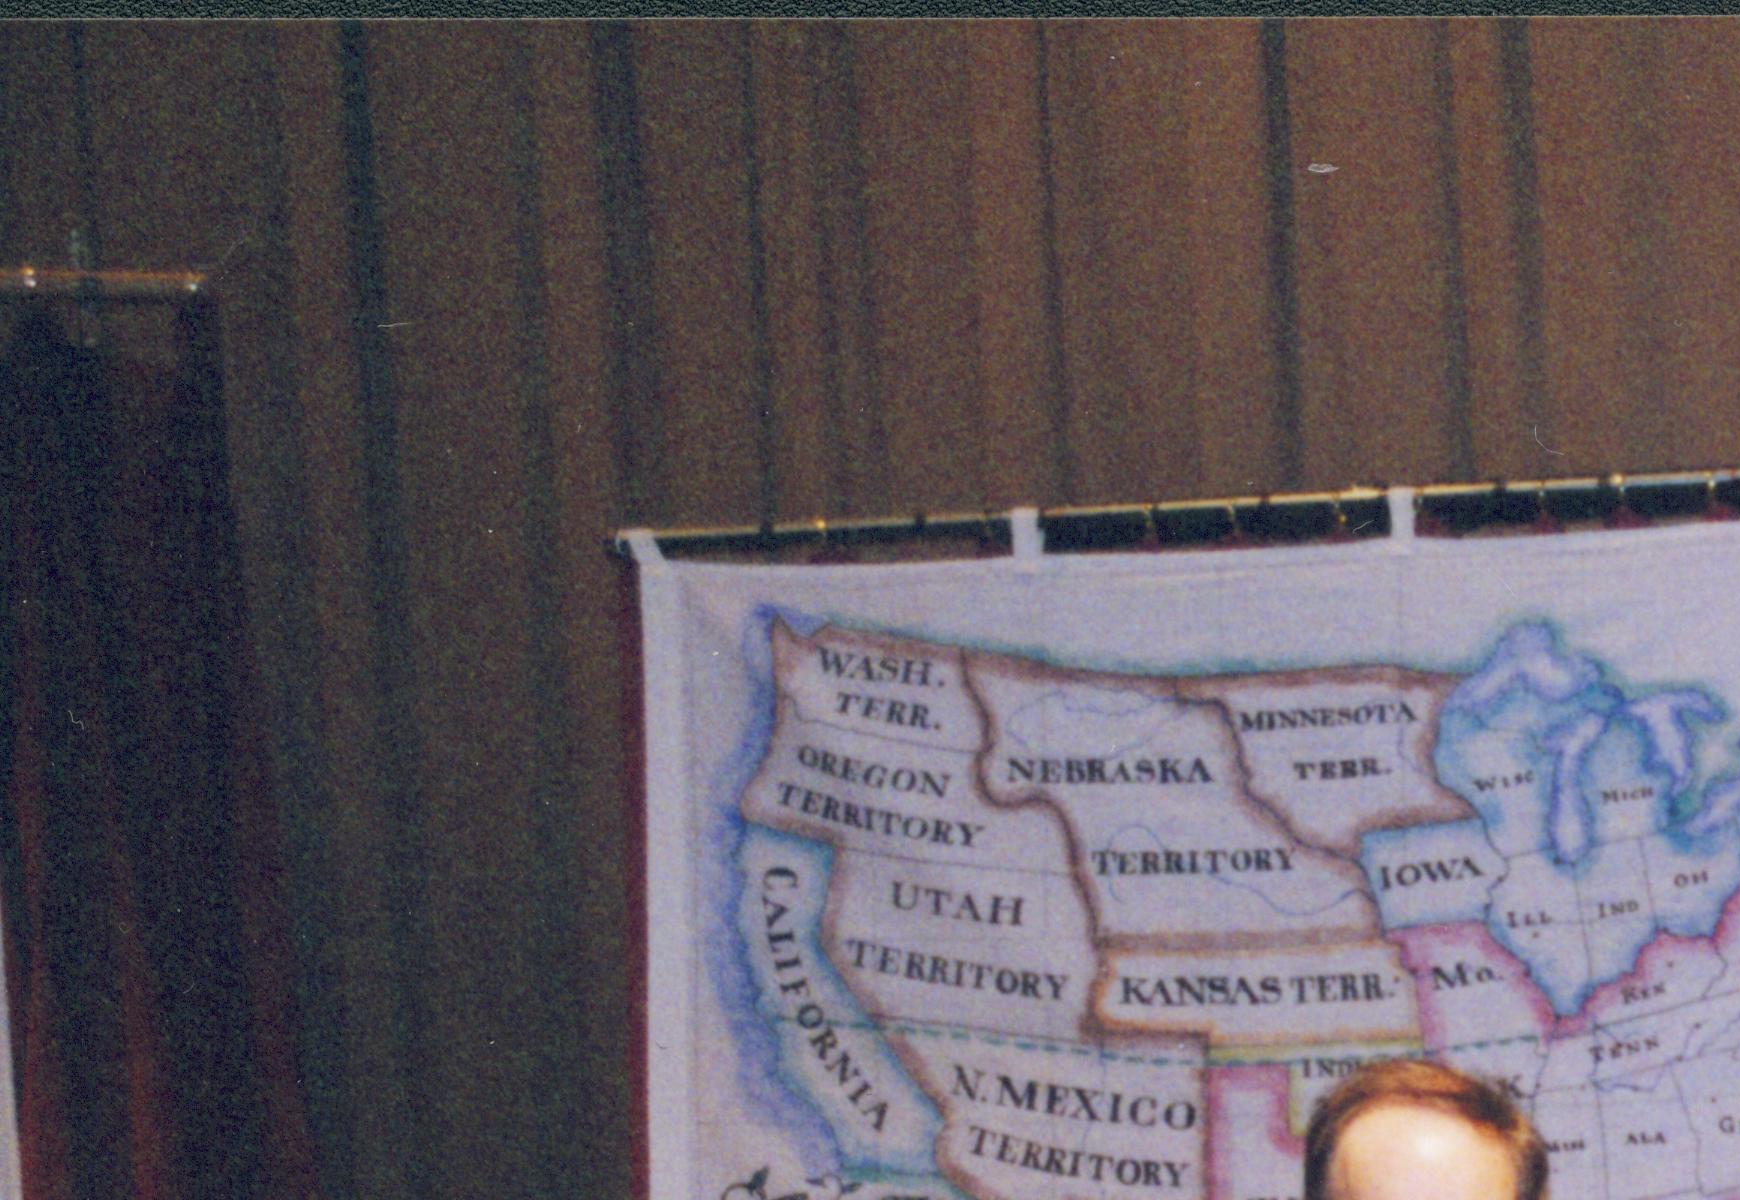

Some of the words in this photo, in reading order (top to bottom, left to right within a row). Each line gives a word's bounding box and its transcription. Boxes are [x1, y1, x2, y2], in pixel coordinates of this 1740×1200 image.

[816, 647, 946, 687] WASH.
[837, 692, 941, 730] TERR.
[1240, 702, 1419, 732] MINNESOTA
[797, 744, 951, 798] OREGON
[1007, 757, 1216, 785] NEBRASKA
[1294, 756, 1392, 781] TERR.
[779, 782, 986, 848] TERRITORY
[1092, 848, 1296, 876] TERRITORY
[1379, 856, 1484, 892] IOWA
[891, 881, 1025, 927] UTAH
[846, 939, 1070, 1002] TERRITORY
[1121, 976, 1282, 1006] KANSAS
[1289, 972, 1394, 1001] TERR.
[762, 867, 890, 1133] CALIFORNIA
[968, 1125, 1192, 1188] TERRITORY
